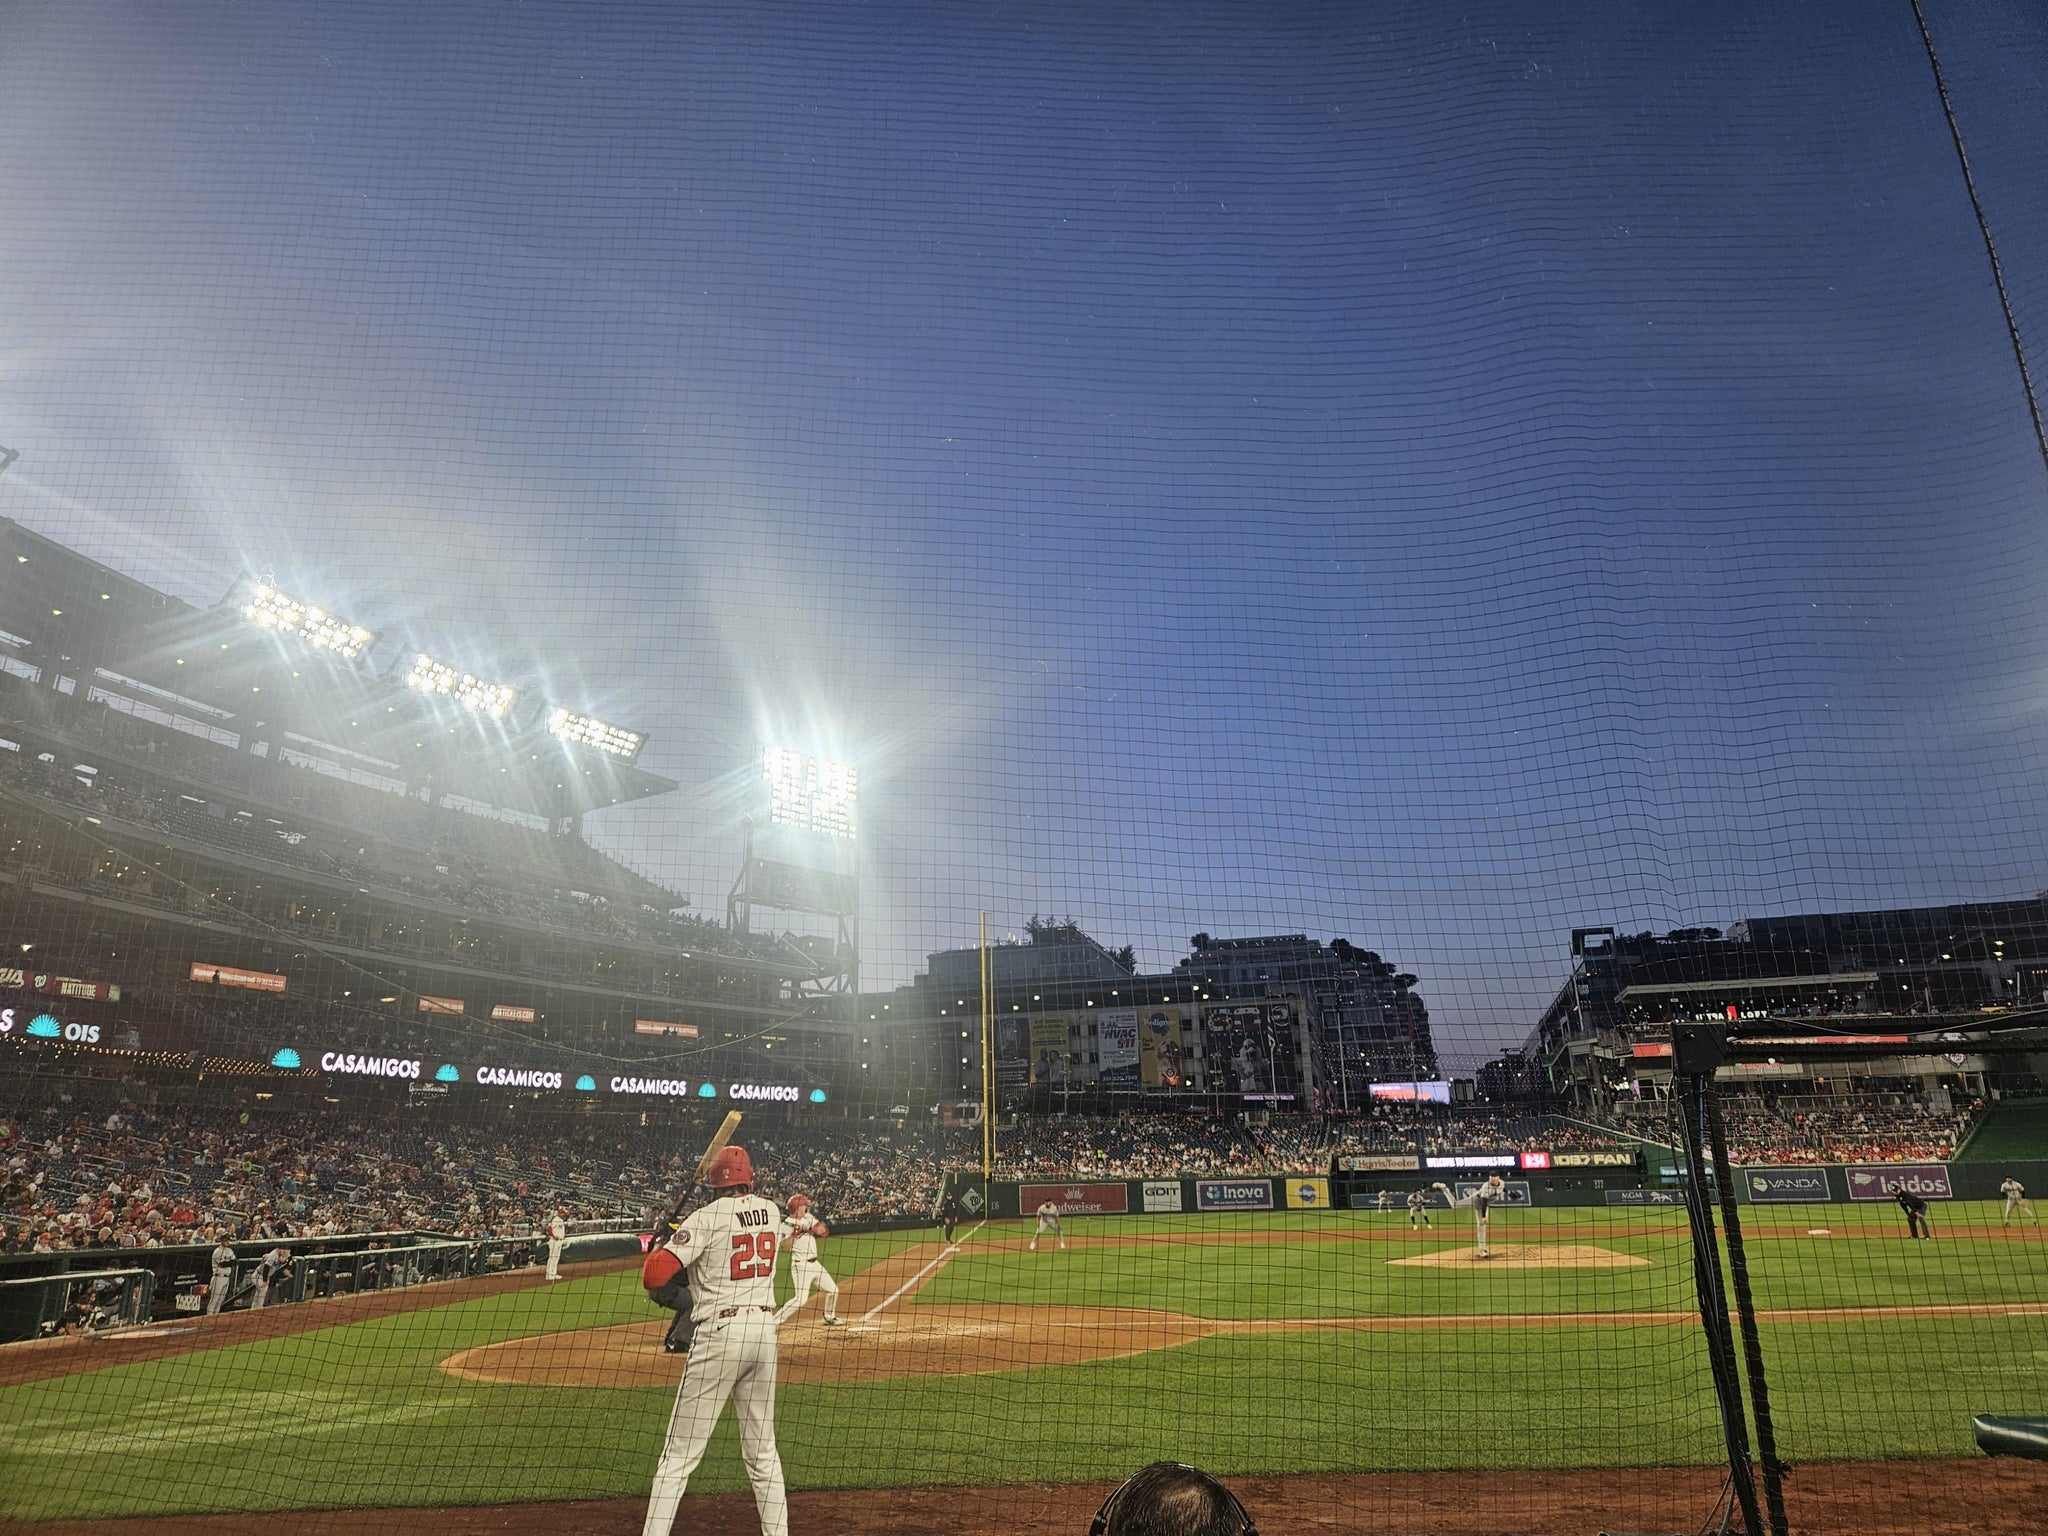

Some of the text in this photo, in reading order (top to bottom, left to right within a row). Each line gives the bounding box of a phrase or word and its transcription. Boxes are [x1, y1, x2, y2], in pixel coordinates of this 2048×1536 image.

[61, 982, 97, 997] NATITUDE
[65, 1023, 100, 1043] OIS
[321, 1052, 421, 1079] CASAMIGOS
[476, 1067, 562, 1089] CASAMIGOS
[610, 1076, 687, 1096] CASAMIGOS
[729, 1084, 799, 1101] CASAMIGOS
[1358, 1157, 1417, 1169] Harris Teeter
[1593, 1153, 1631, 1165] FAN
[1145, 1187, 1178, 1196] GDIT
[1768, 1178, 1822, 1189] VANDA
[1223, 1186, 1264, 1199] Inova
[1056, 1202, 1102, 1212] udweiser
[736, 1209, 769, 1228] WOOD
[730, 1232, 776, 1280] 29
